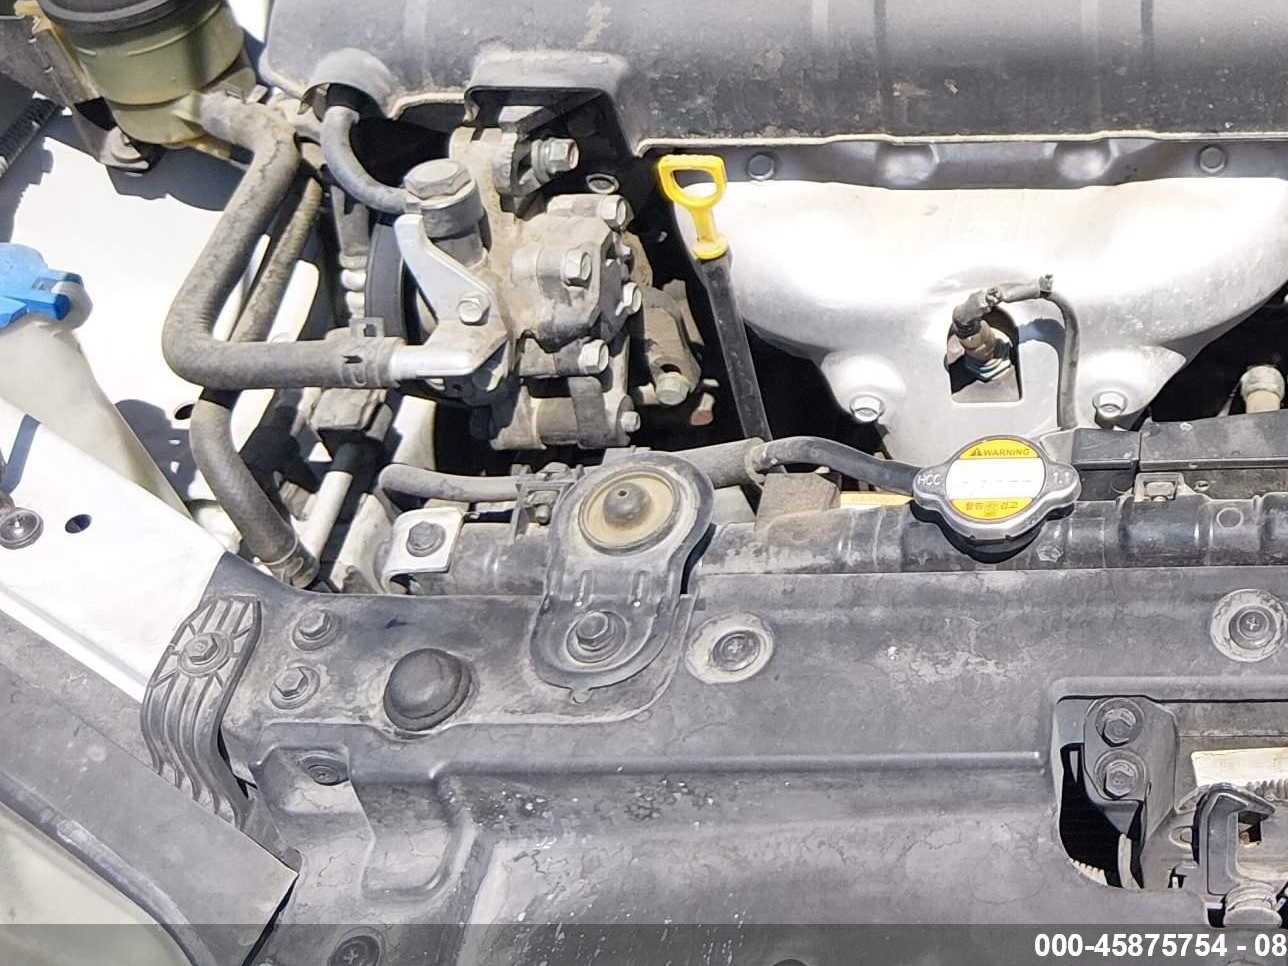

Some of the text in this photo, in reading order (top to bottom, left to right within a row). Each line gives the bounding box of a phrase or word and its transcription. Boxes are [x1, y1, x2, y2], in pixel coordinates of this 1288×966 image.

[984, 448, 1030, 457] WARNING
[917, 474, 942, 486] HCC
[1052, 471, 1071, 484] 1.1
